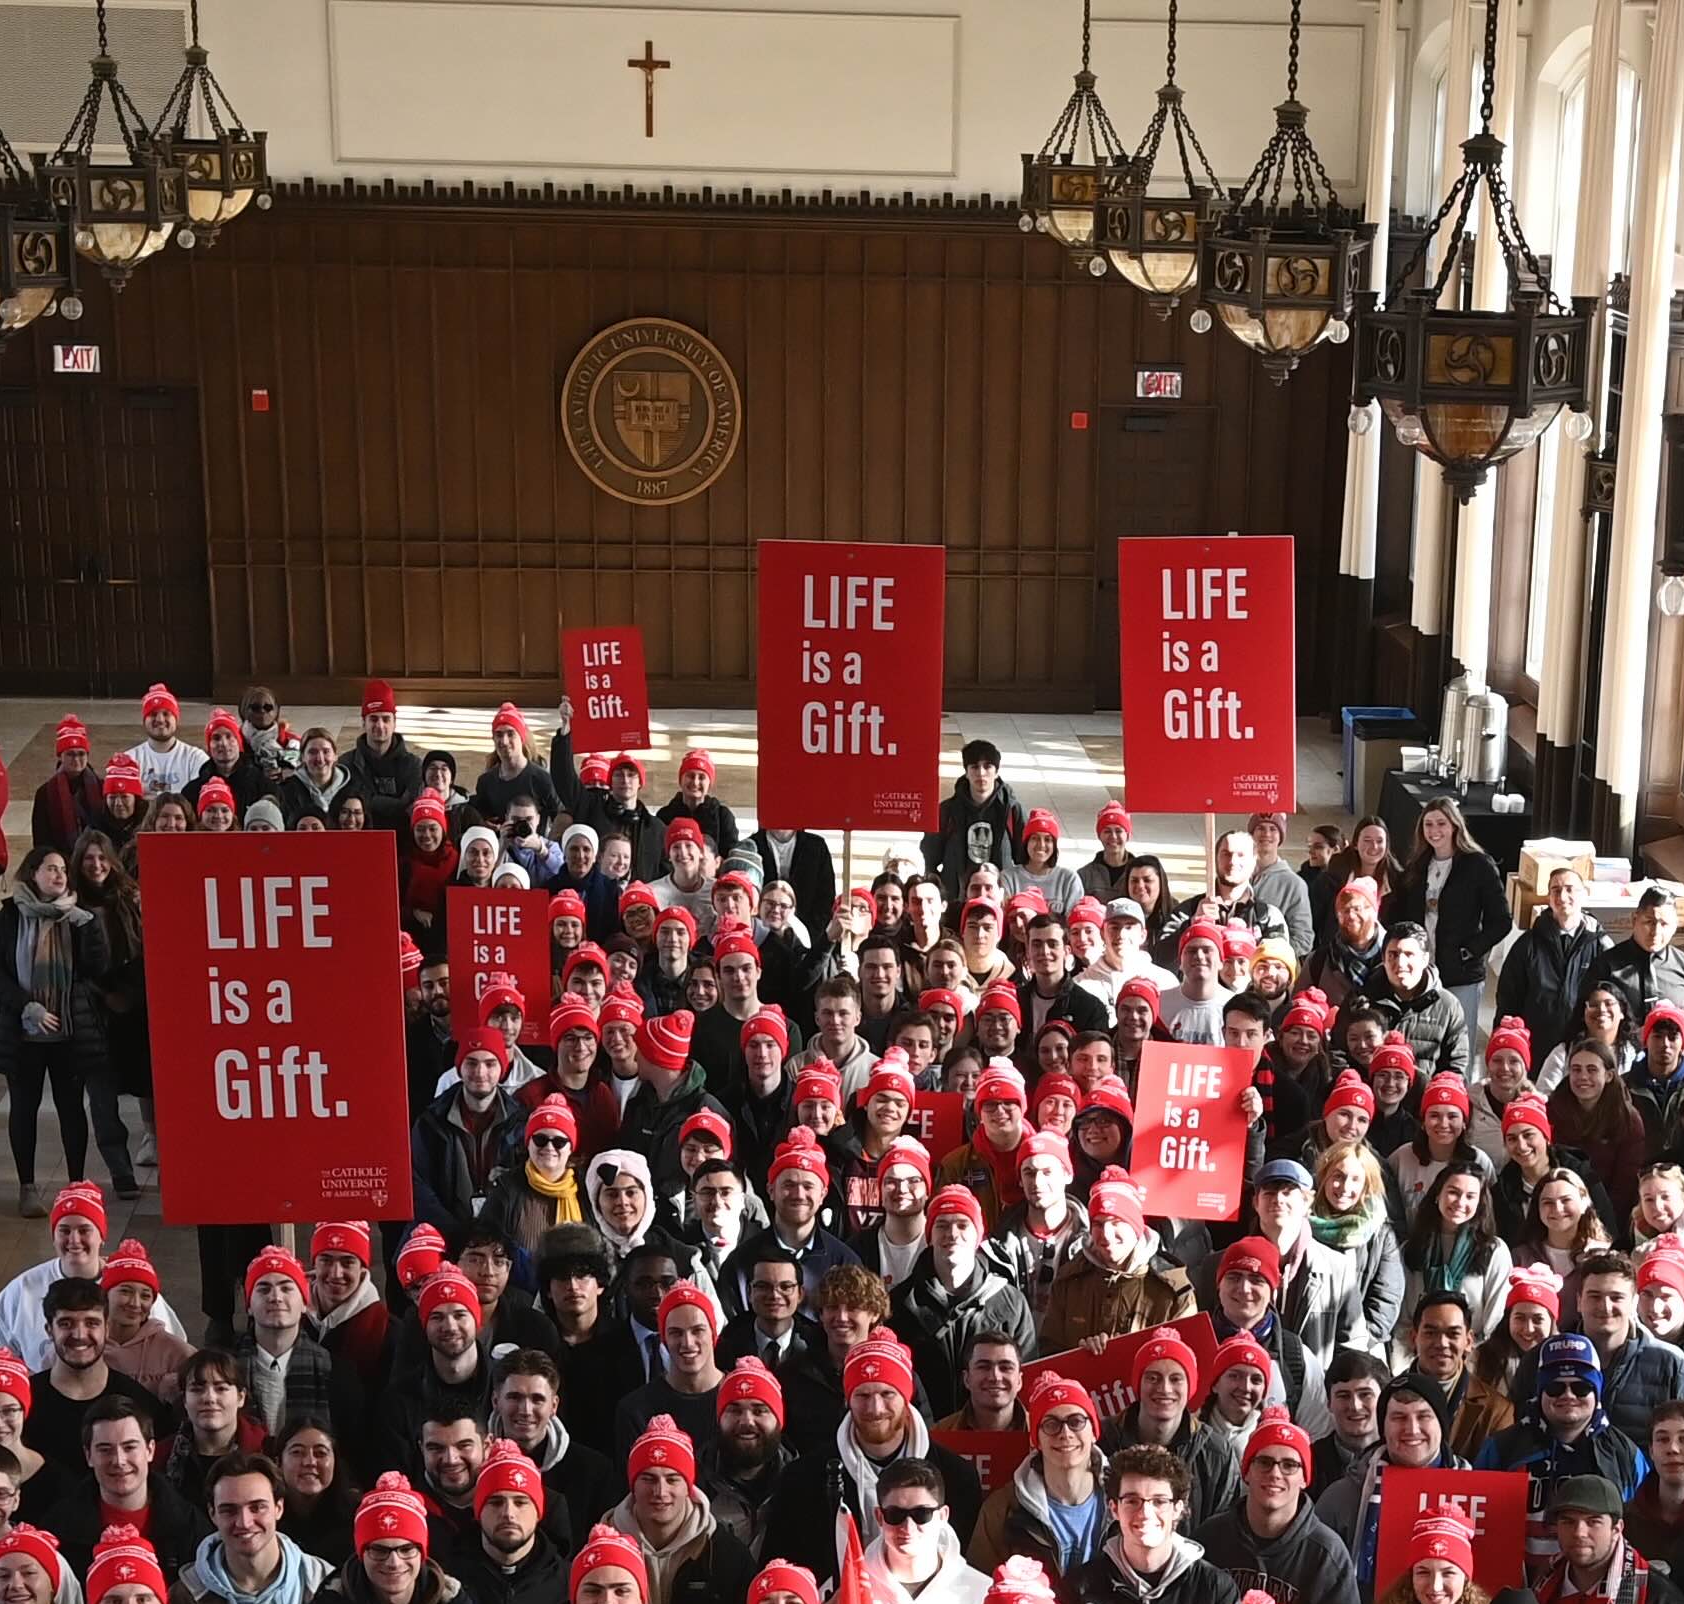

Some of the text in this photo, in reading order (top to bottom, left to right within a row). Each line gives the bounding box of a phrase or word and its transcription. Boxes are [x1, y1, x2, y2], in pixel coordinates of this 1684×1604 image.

[62, 346, 94, 369] EXIT
[609, 327, 713, 372] UNIVERSITY
[1146, 374, 1177, 395] EXIT
[803, 575, 895, 632] LIFE
[1162, 568, 1248, 619] LIFE
[583, 642, 621, 667] LIFE
[802, 642, 862, 685] is a
[1162, 632, 1219, 673] is a
[585, 672, 610, 689] is a
[588, 696, 629, 719] Gift.
[1164, 687, 1254, 740] Gift.
[802, 700, 897, 756] Gift.
[204, 875, 332, 949] LIFE
[473, 905, 522, 936] LIFE
[473, 940, 506, 964] is a
[208, 967, 293, 1024] is a
[214, 1045, 348, 1119] Gift.
[1167, 1062, 1222, 1099] LIFE
[1164, 1100, 1199, 1129] is a
[332, 1167, 388, 1177] CATHOLIC
[1160, 1136, 1216, 1172] Gift.
[321, 1178, 386, 1189] UNIVERSITY
[1548, 1340, 1587, 1353] TRUMP
